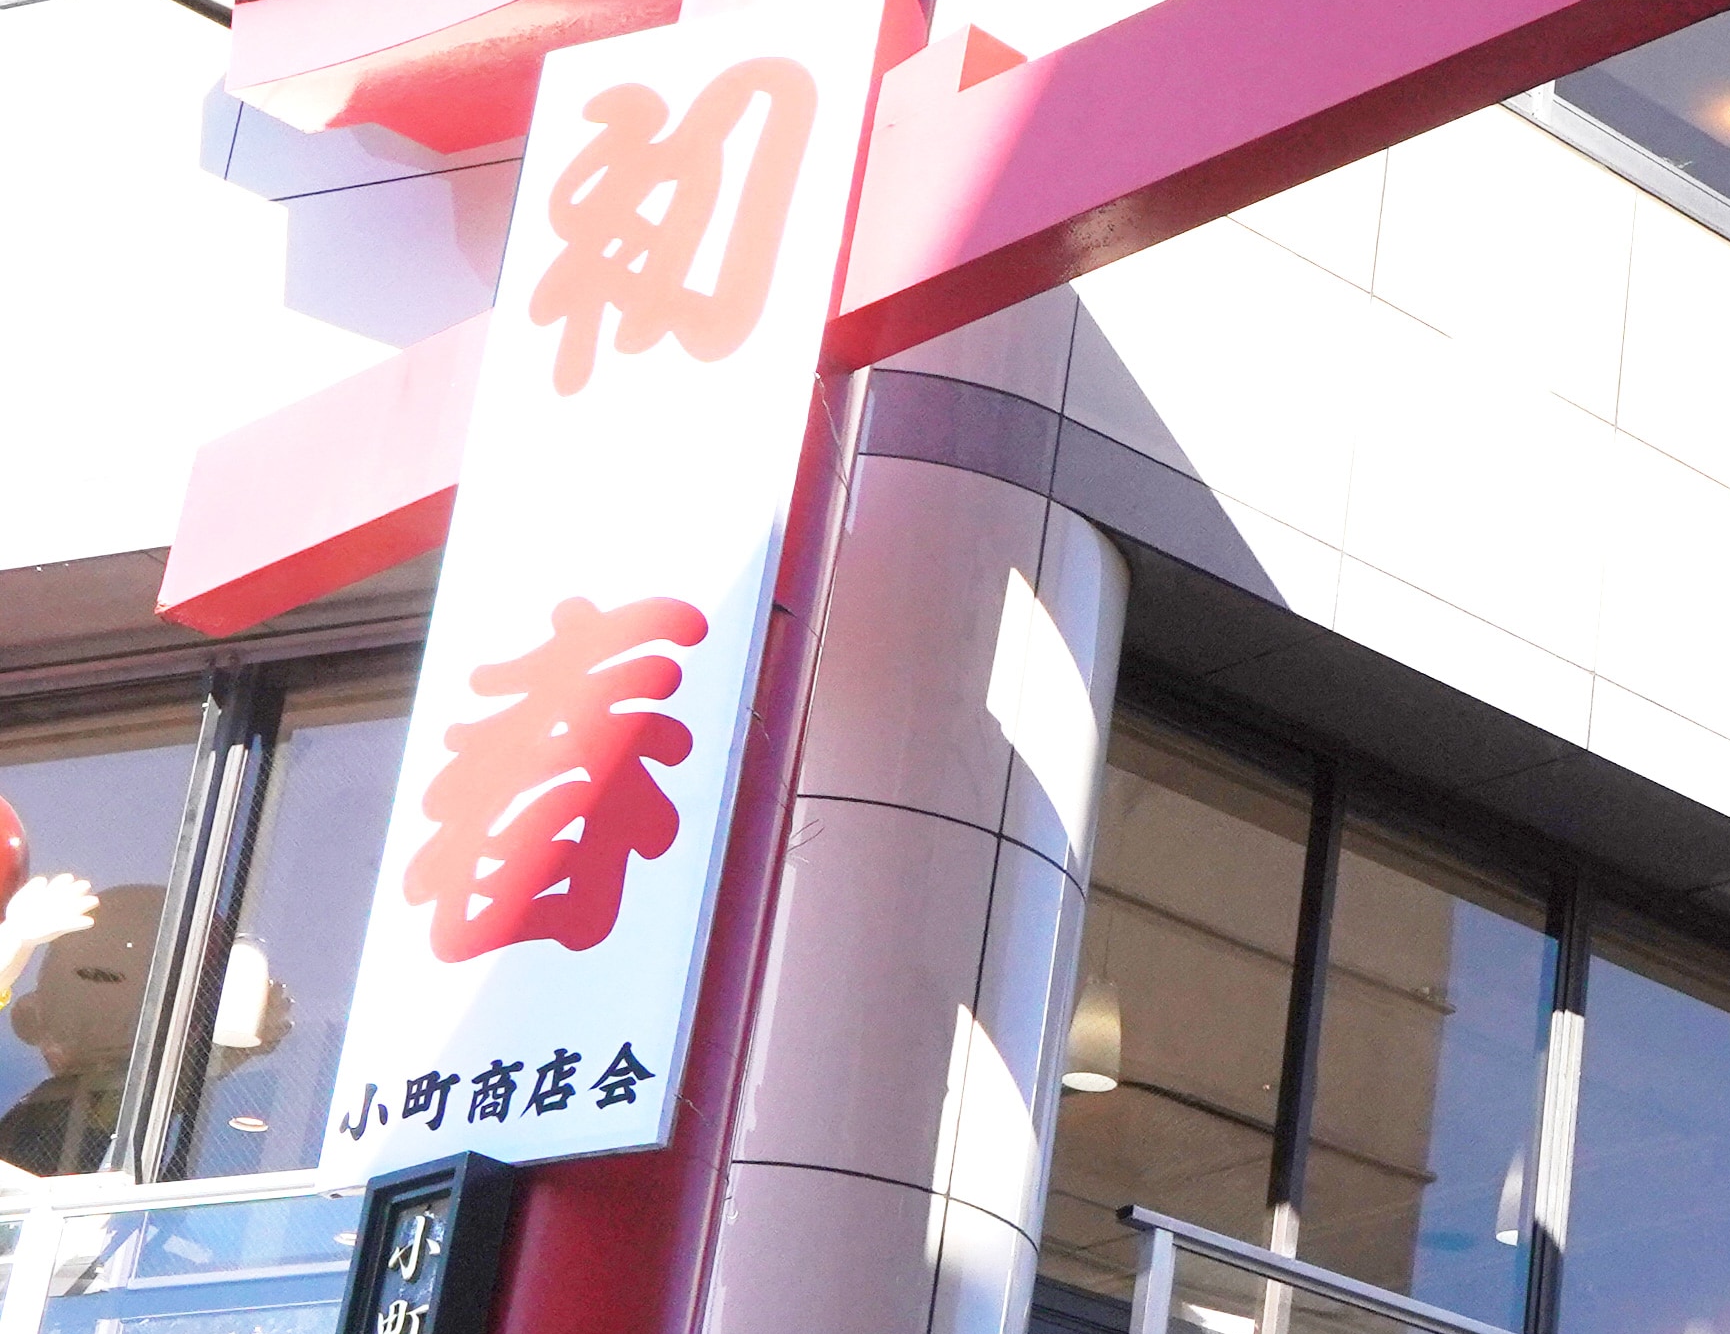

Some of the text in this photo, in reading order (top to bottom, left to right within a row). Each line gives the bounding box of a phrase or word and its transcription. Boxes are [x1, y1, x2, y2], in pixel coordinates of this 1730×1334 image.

[403, 56, 819, 964] 初春
[340, 1040, 658, 1141] 小町商店会
